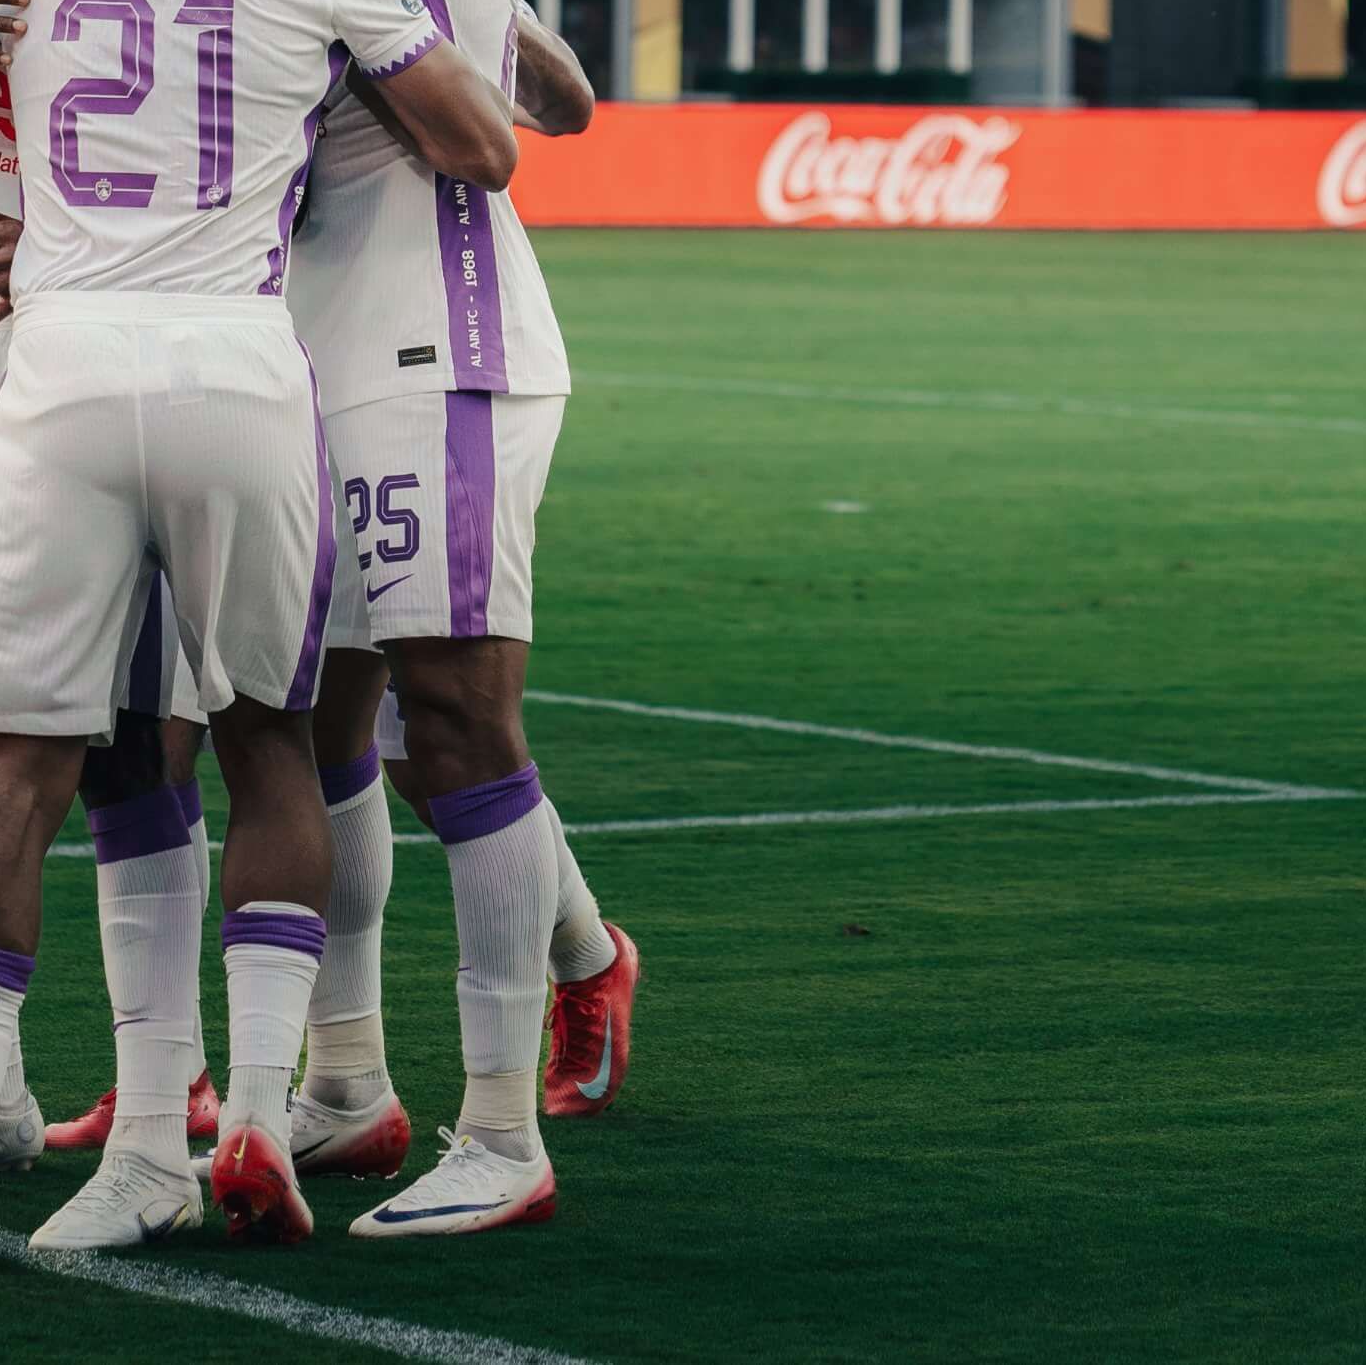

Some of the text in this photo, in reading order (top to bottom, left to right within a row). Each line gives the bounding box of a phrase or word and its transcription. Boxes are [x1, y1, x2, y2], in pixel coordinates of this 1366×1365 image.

[461, 249, 478, 287] 1968
[467, 309, 479, 325] FC
[344, 472, 421, 572] 25
